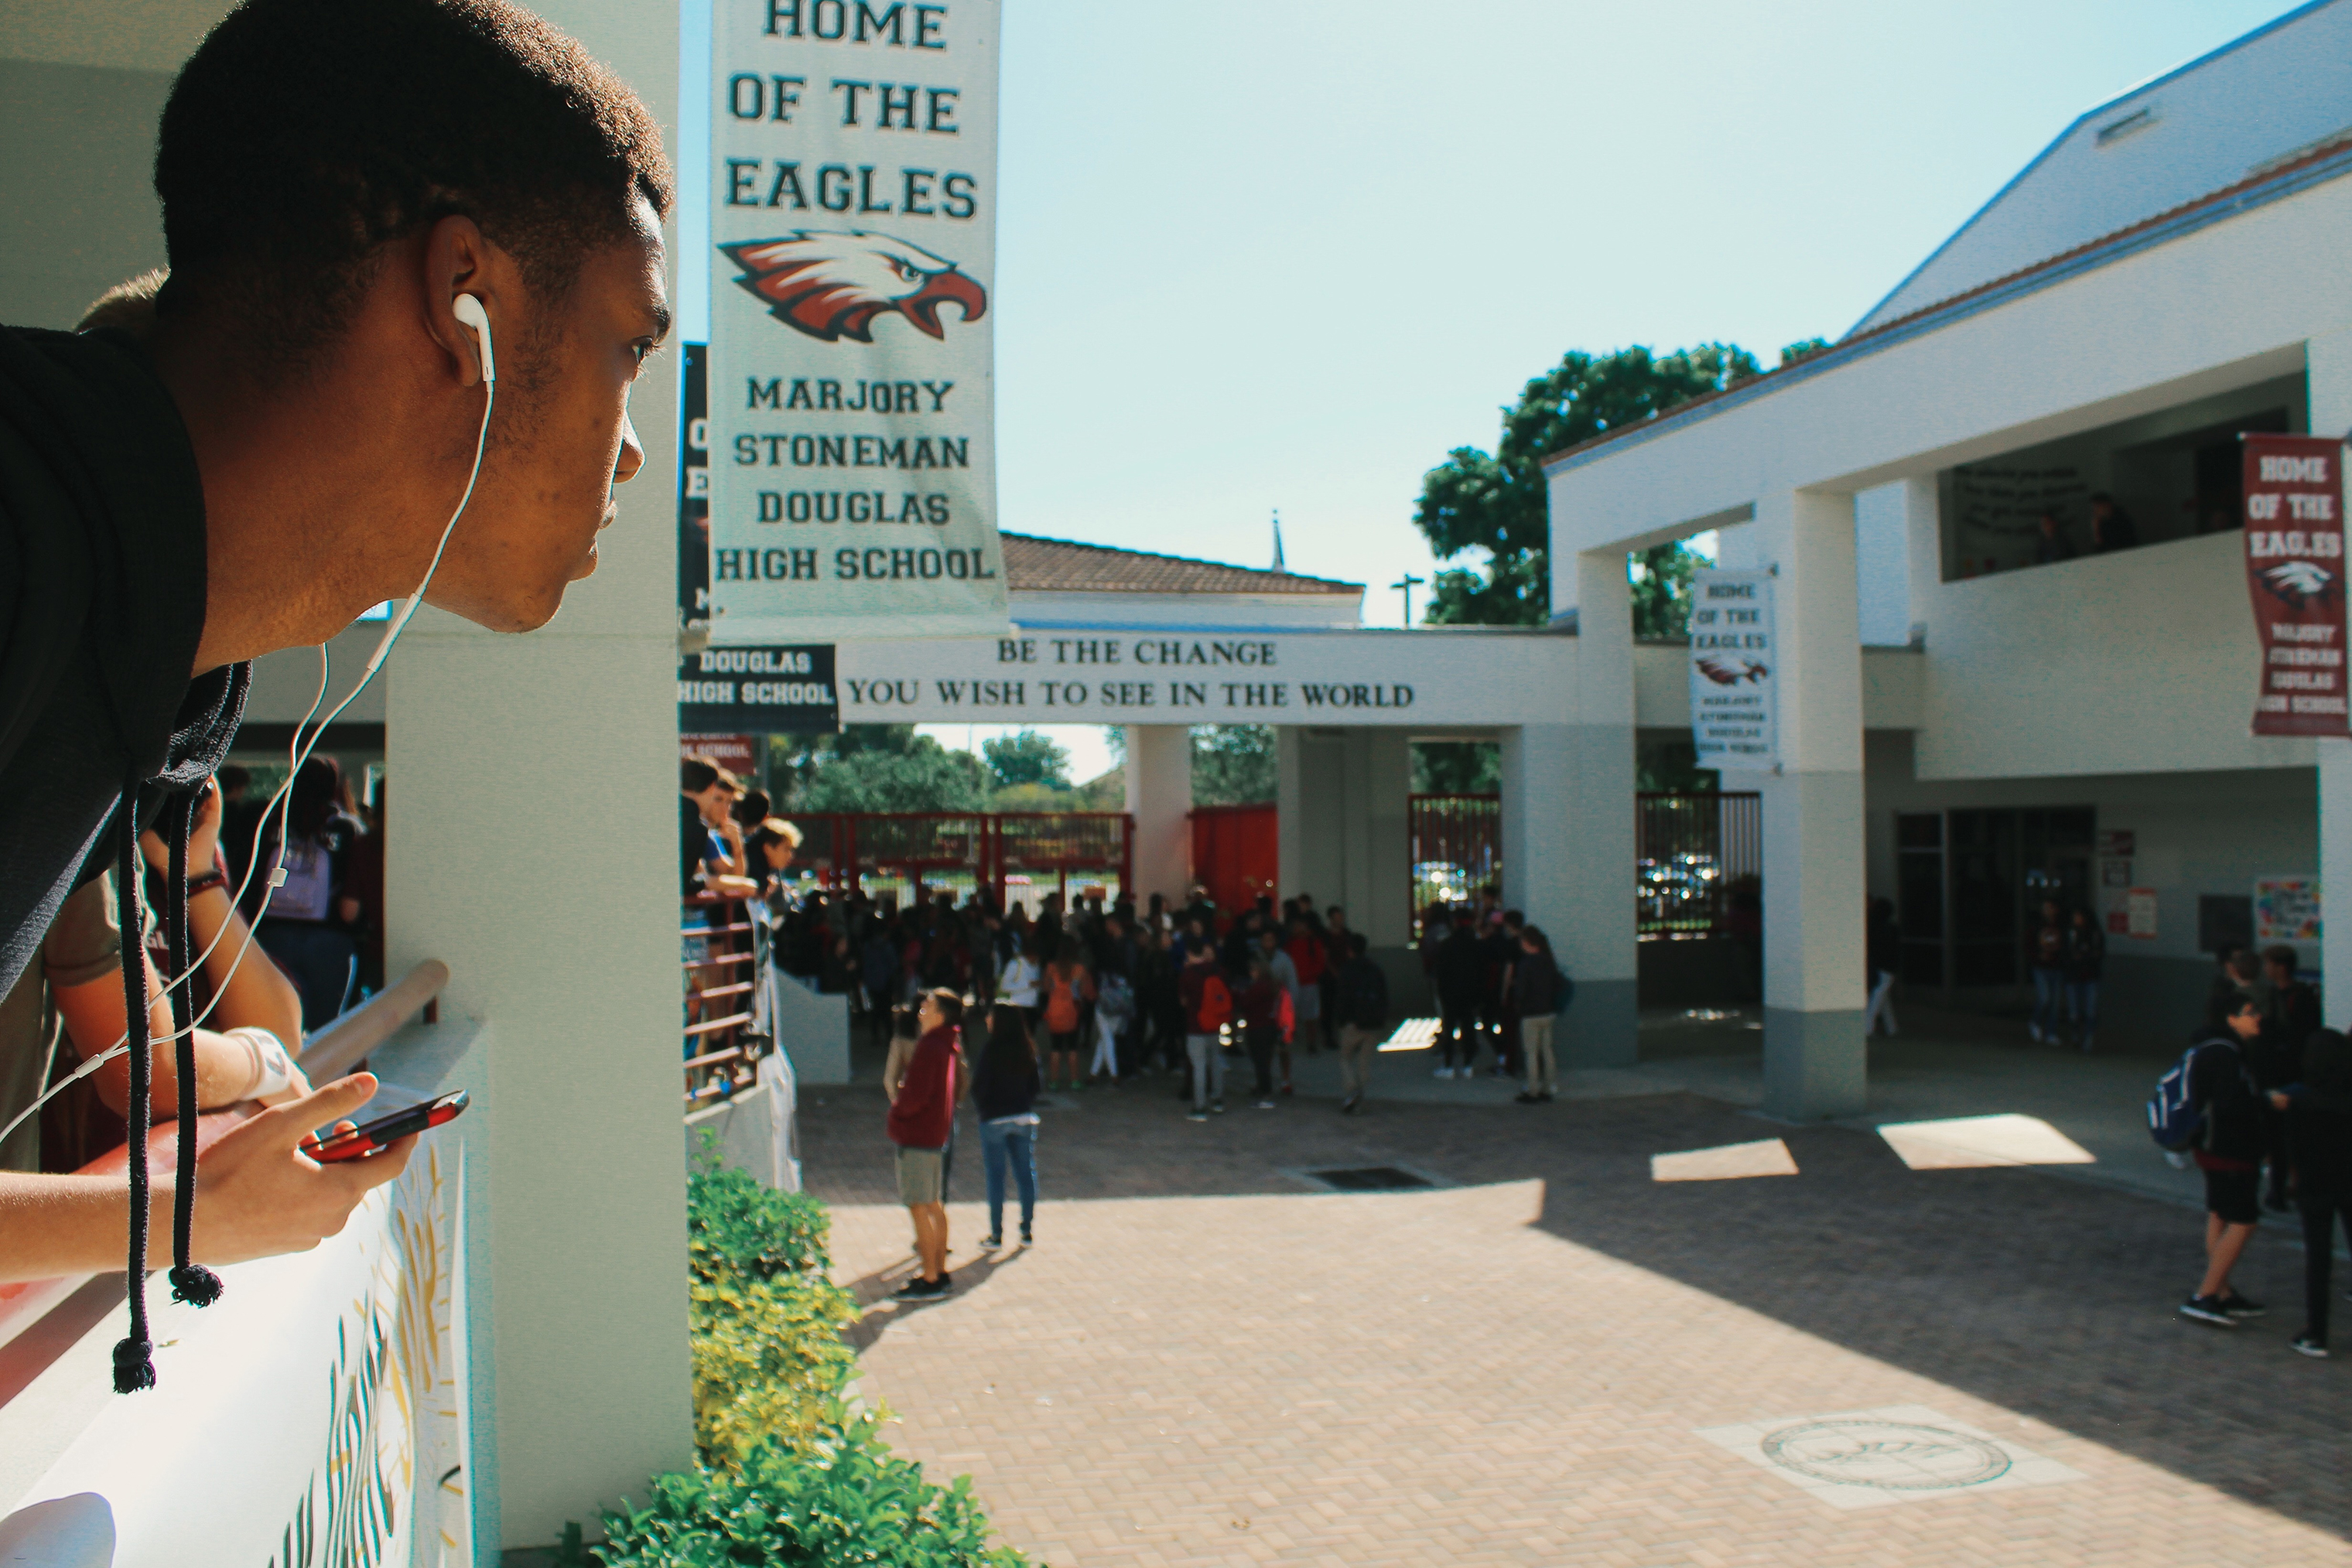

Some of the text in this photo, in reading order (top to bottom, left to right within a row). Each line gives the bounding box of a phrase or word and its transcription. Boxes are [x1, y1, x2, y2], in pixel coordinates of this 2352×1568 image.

[762, 0, 948, 51] HOME
[729, 70, 960, 135] OF THE
[724, 157, 977, 220] EAGLES
[746, 376, 956, 414] MARJORY
[733, 433, 969, 469] STONEMAN
[2259, 456, 2329, 483] HOME
[757, 490, 951, 525] DOUGLAS
[2248, 493, 2334, 521] OF THE
[2248, 531, 2343, 558] EAGLES
[716, 548, 997, 581] HIGH SCHOOL
[699, 650, 812, 675] DOUGLAS
[997, 639, 1278, 667] BE THE CHANGE
[678, 681, 836, 705] HIGH SCHOOL
[846, 679, 1415, 709] YOU WISH TO SEE IN THE WORLD
